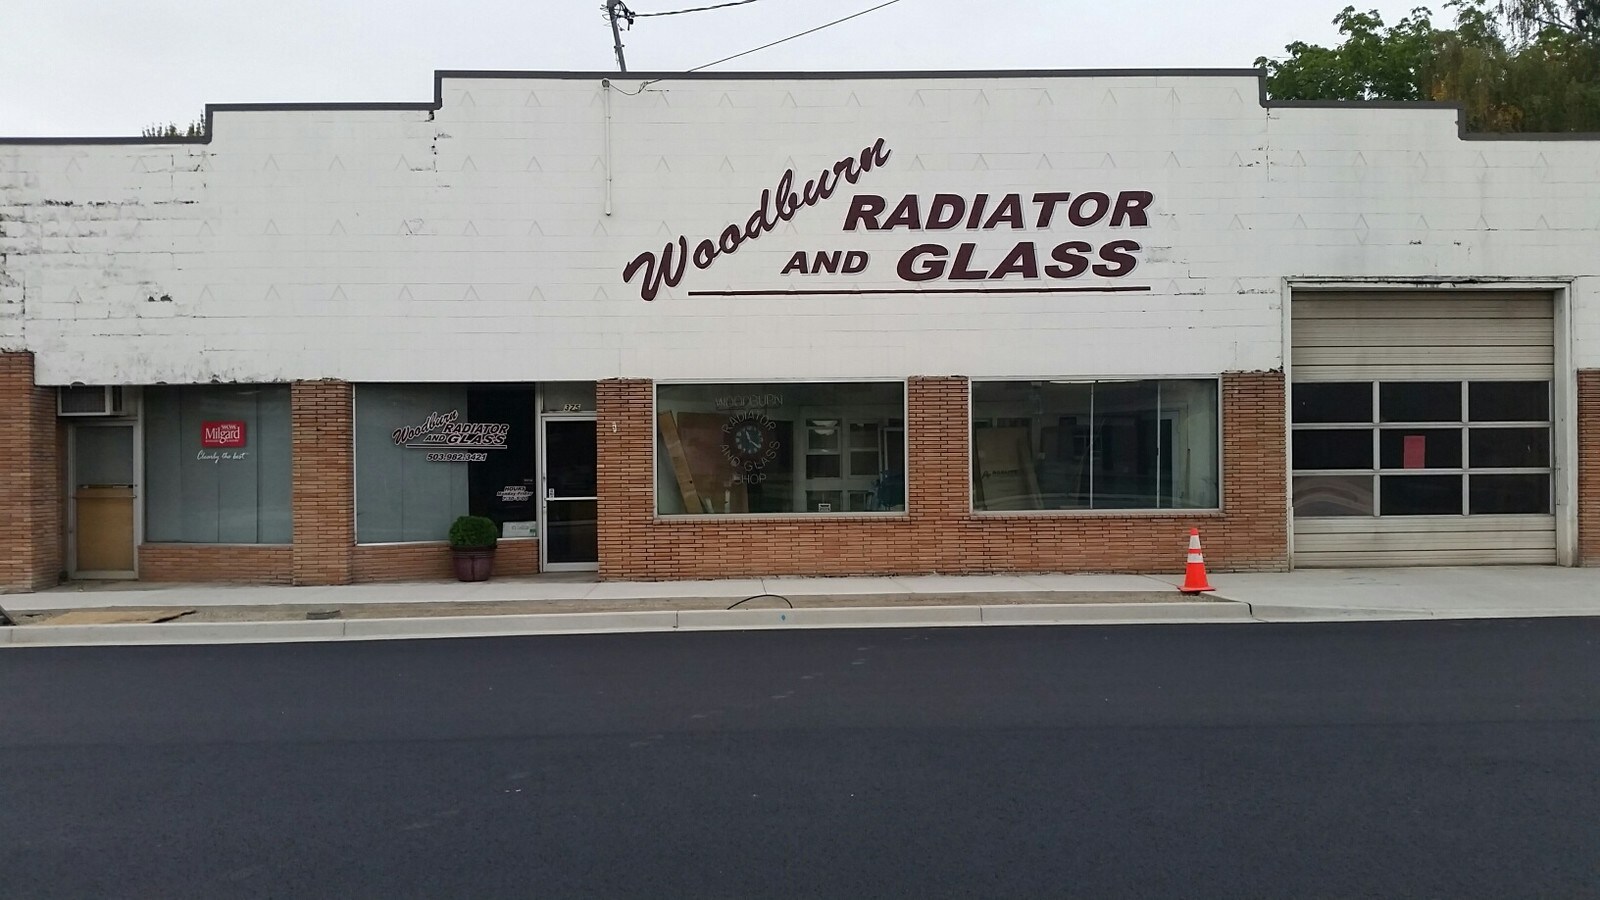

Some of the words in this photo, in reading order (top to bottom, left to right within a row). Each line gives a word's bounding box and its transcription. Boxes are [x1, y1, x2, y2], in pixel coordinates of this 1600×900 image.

[622, 137, 892, 301] Woodburn
[843, 190, 1154, 231] RADIATOR
[780, 250, 870, 275] AND
[896, 239, 1142, 281] GLASS
[715, 394, 784, 408] WOODBURN
[392, 409, 458, 445] Woodburn
[443, 423, 510, 435] RADIATOR
[721, 411, 777, 434] RADIATOR
[205, 426, 240, 444] Milgard
[424, 434, 446, 442] AND
[446, 434, 505, 445] GLASS
[197, 449, 219, 463] Clearly
[426, 452, 487, 461] 503.982.3421
[719, 444, 741, 467] AND
[744, 440, 780, 472] GLASS
[734, 473, 767, 485] SHOP
